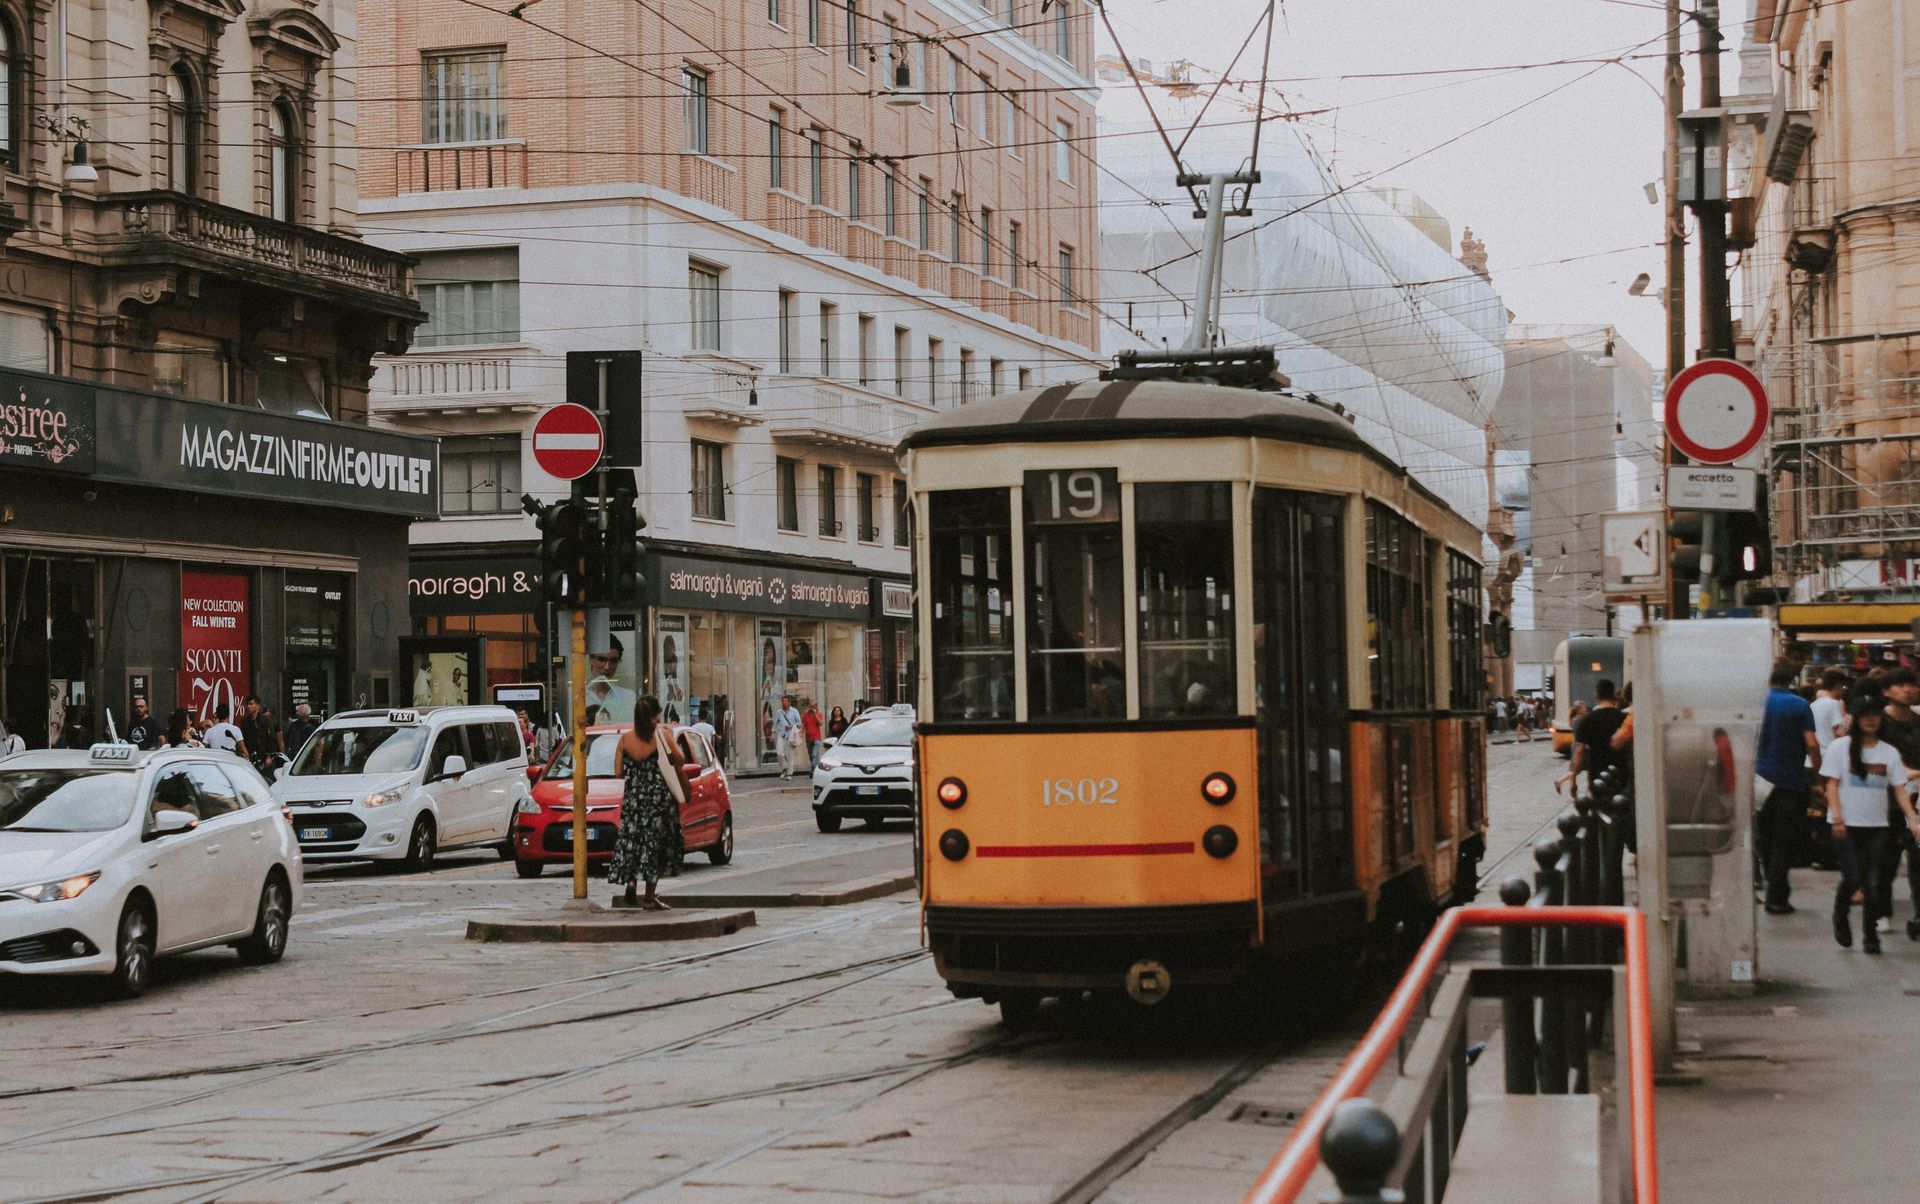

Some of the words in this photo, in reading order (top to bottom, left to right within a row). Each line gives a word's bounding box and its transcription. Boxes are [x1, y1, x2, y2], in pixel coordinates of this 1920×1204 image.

[1688, 473, 1734, 483] eccetto
[1048, 471, 1102, 519] 19
[513, 571, 532, 592] &
[670, 569, 725, 599] salmoiraghi
[325, 591, 341, 600] OUTLET
[791, 581, 837, 607] salmoiraghi
[184, 598, 201, 611] NEW
[202, 599, 244, 613] COLLECTION
[192, 615, 208, 627] FALL
[209, 616, 236, 629] WINTER
[186, 648, 242, 673] SCONTI
[392, 712, 412, 721] TAXI
[94, 748, 129, 759] TAXI
[1042, 778, 1119, 807] 1802
